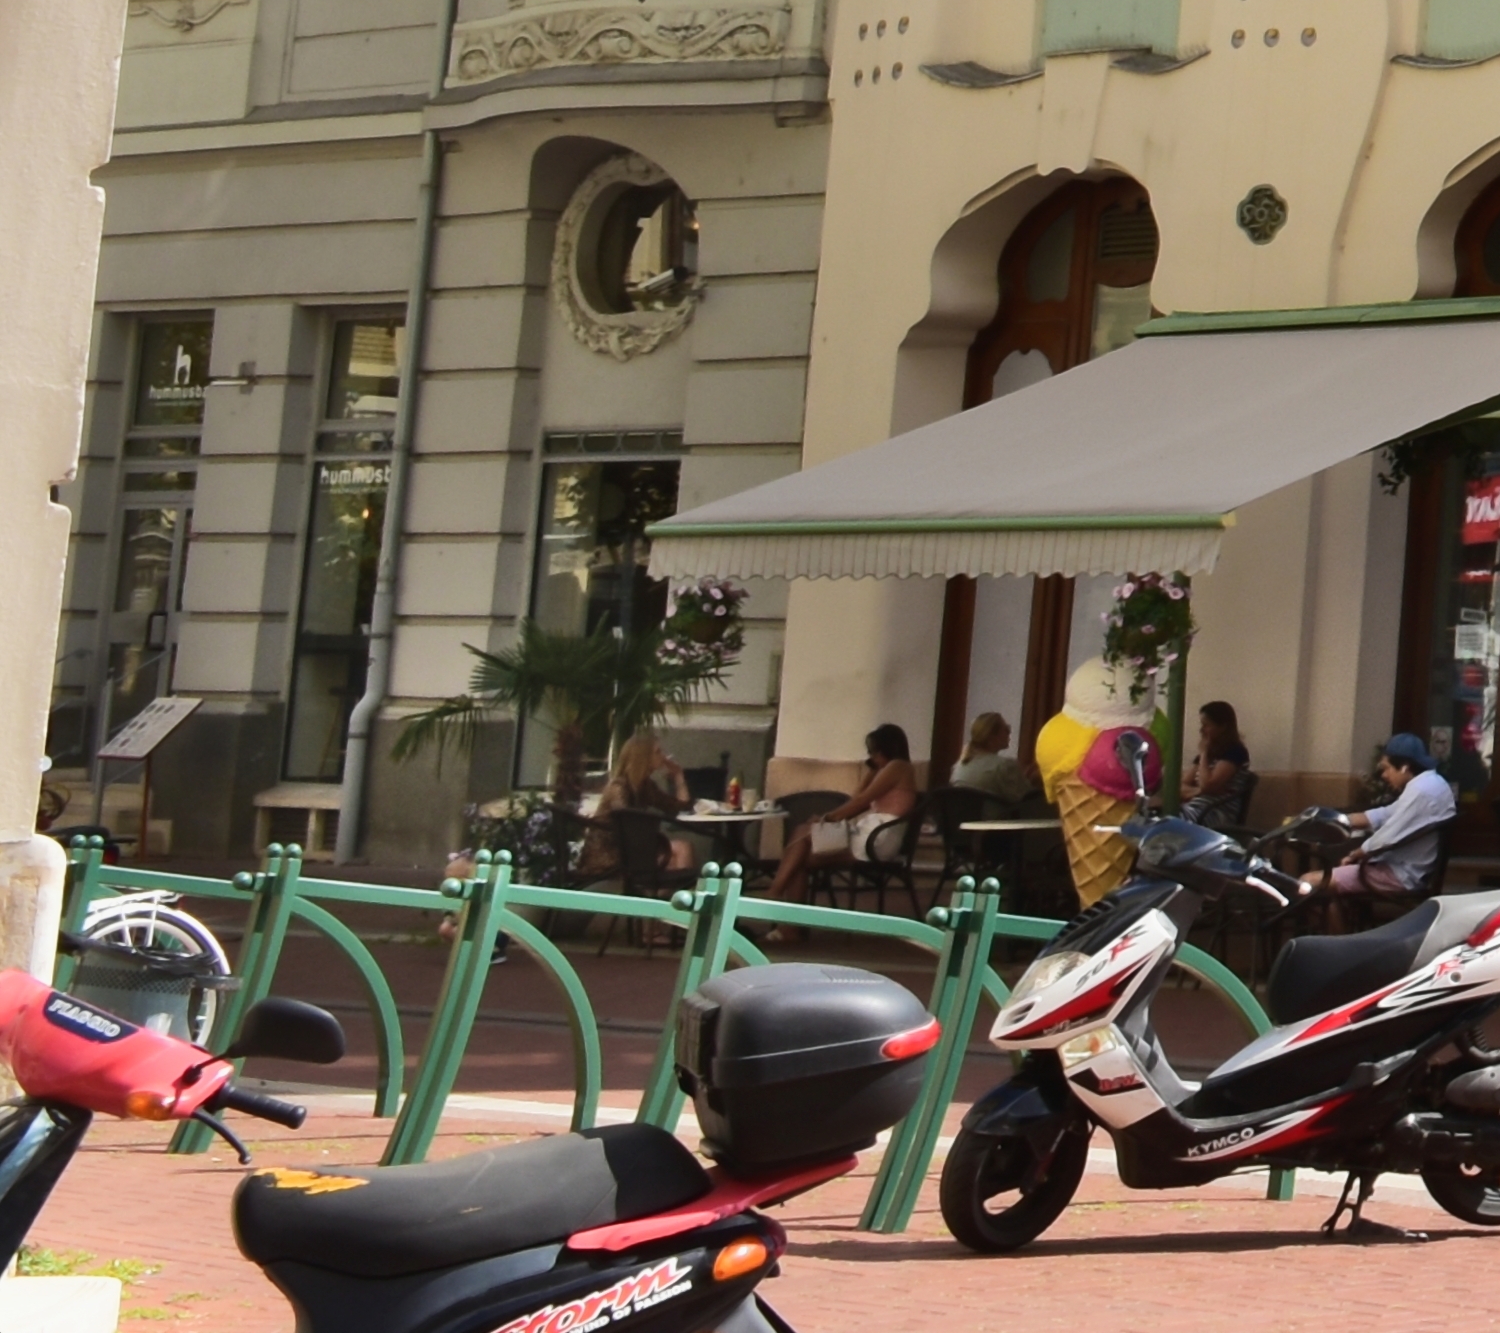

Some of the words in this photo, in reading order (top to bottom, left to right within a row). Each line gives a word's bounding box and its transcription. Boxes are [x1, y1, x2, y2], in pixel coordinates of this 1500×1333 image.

[1187, 1127, 1255, 1157] KYMCO
[611, 1306, 632, 1321] OF
[634, 1280, 693, 1312] PASSION
